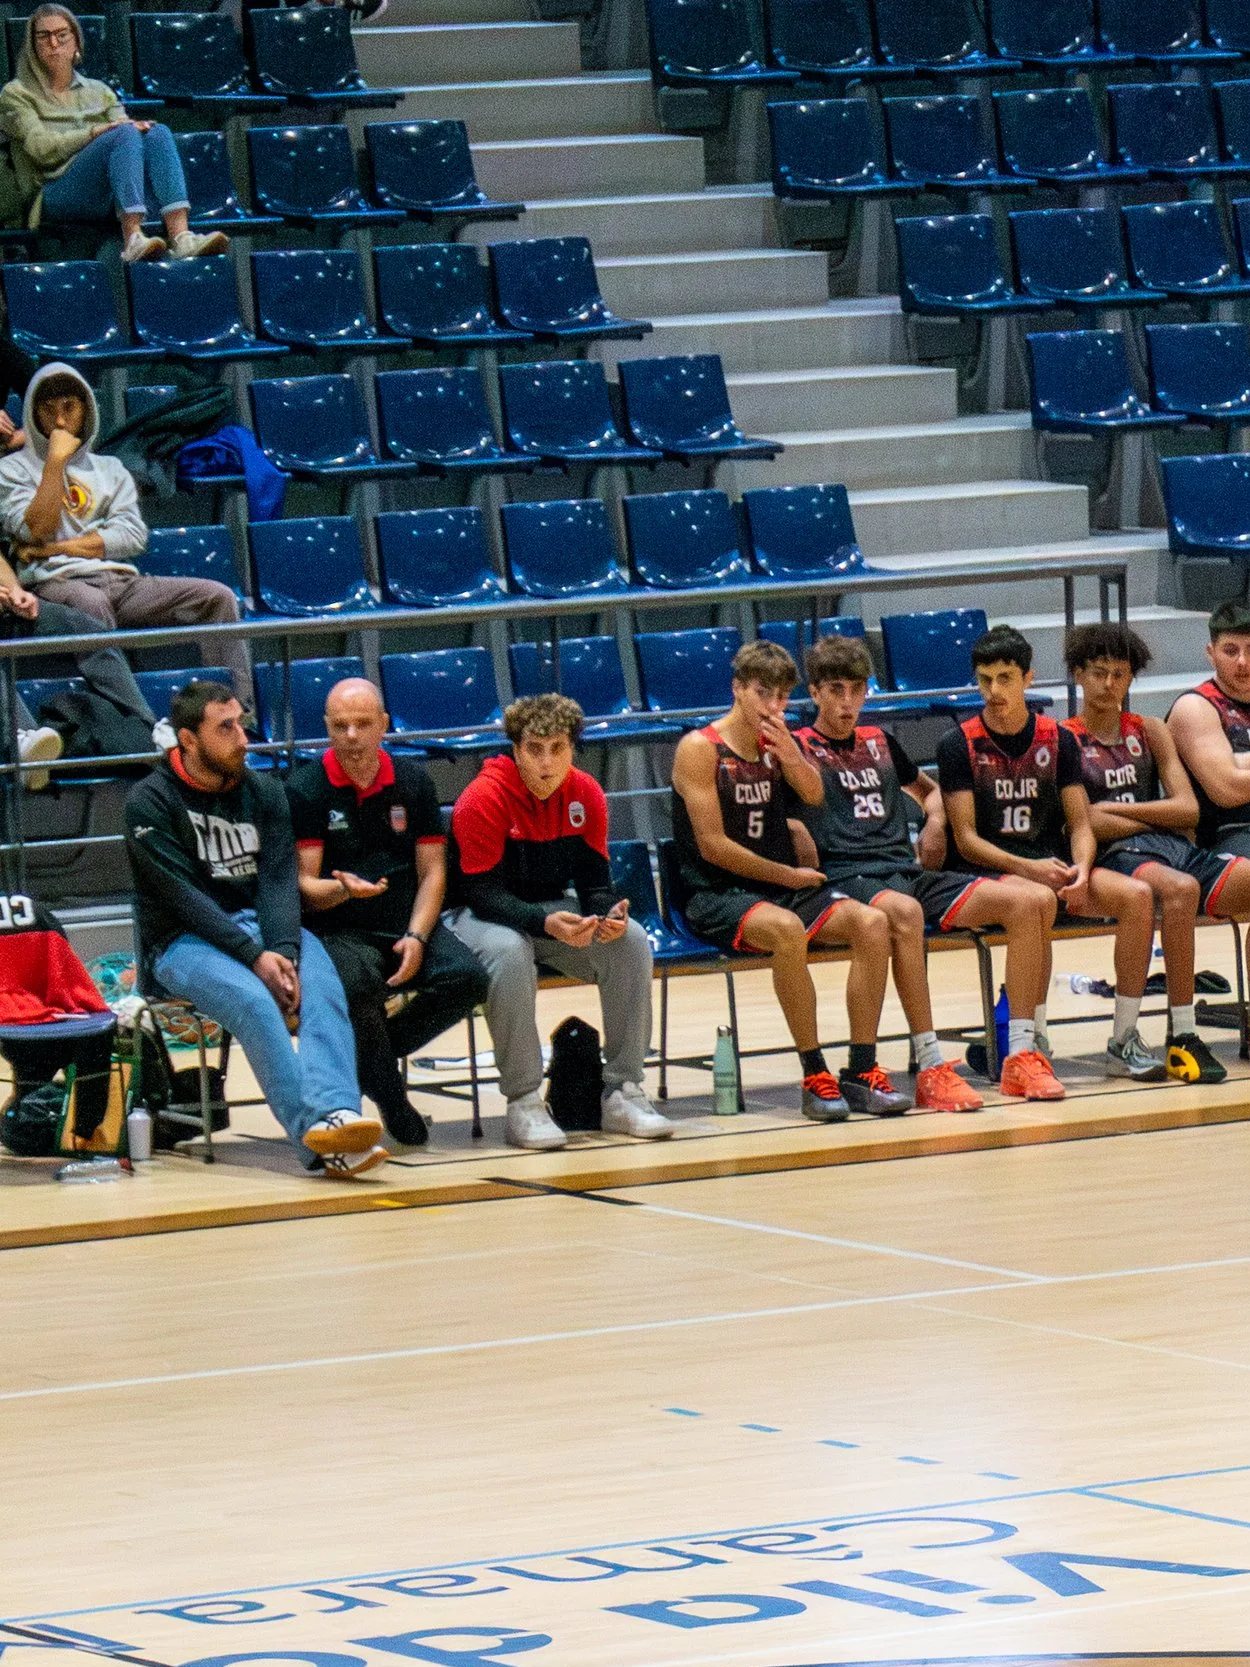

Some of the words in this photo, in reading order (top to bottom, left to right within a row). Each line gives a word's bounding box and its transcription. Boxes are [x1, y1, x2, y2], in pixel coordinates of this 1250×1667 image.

[735, 780, 772, 804] CDJR
[838, 767, 882, 791] CDJR
[995, 777, 1039, 800] CDJR
[853, 792, 885, 819] 26
[747, 810, 764, 839] 5
[1000, 805, 1032, 834] 16
[132, 1516, 1019, 1626] Câmara
